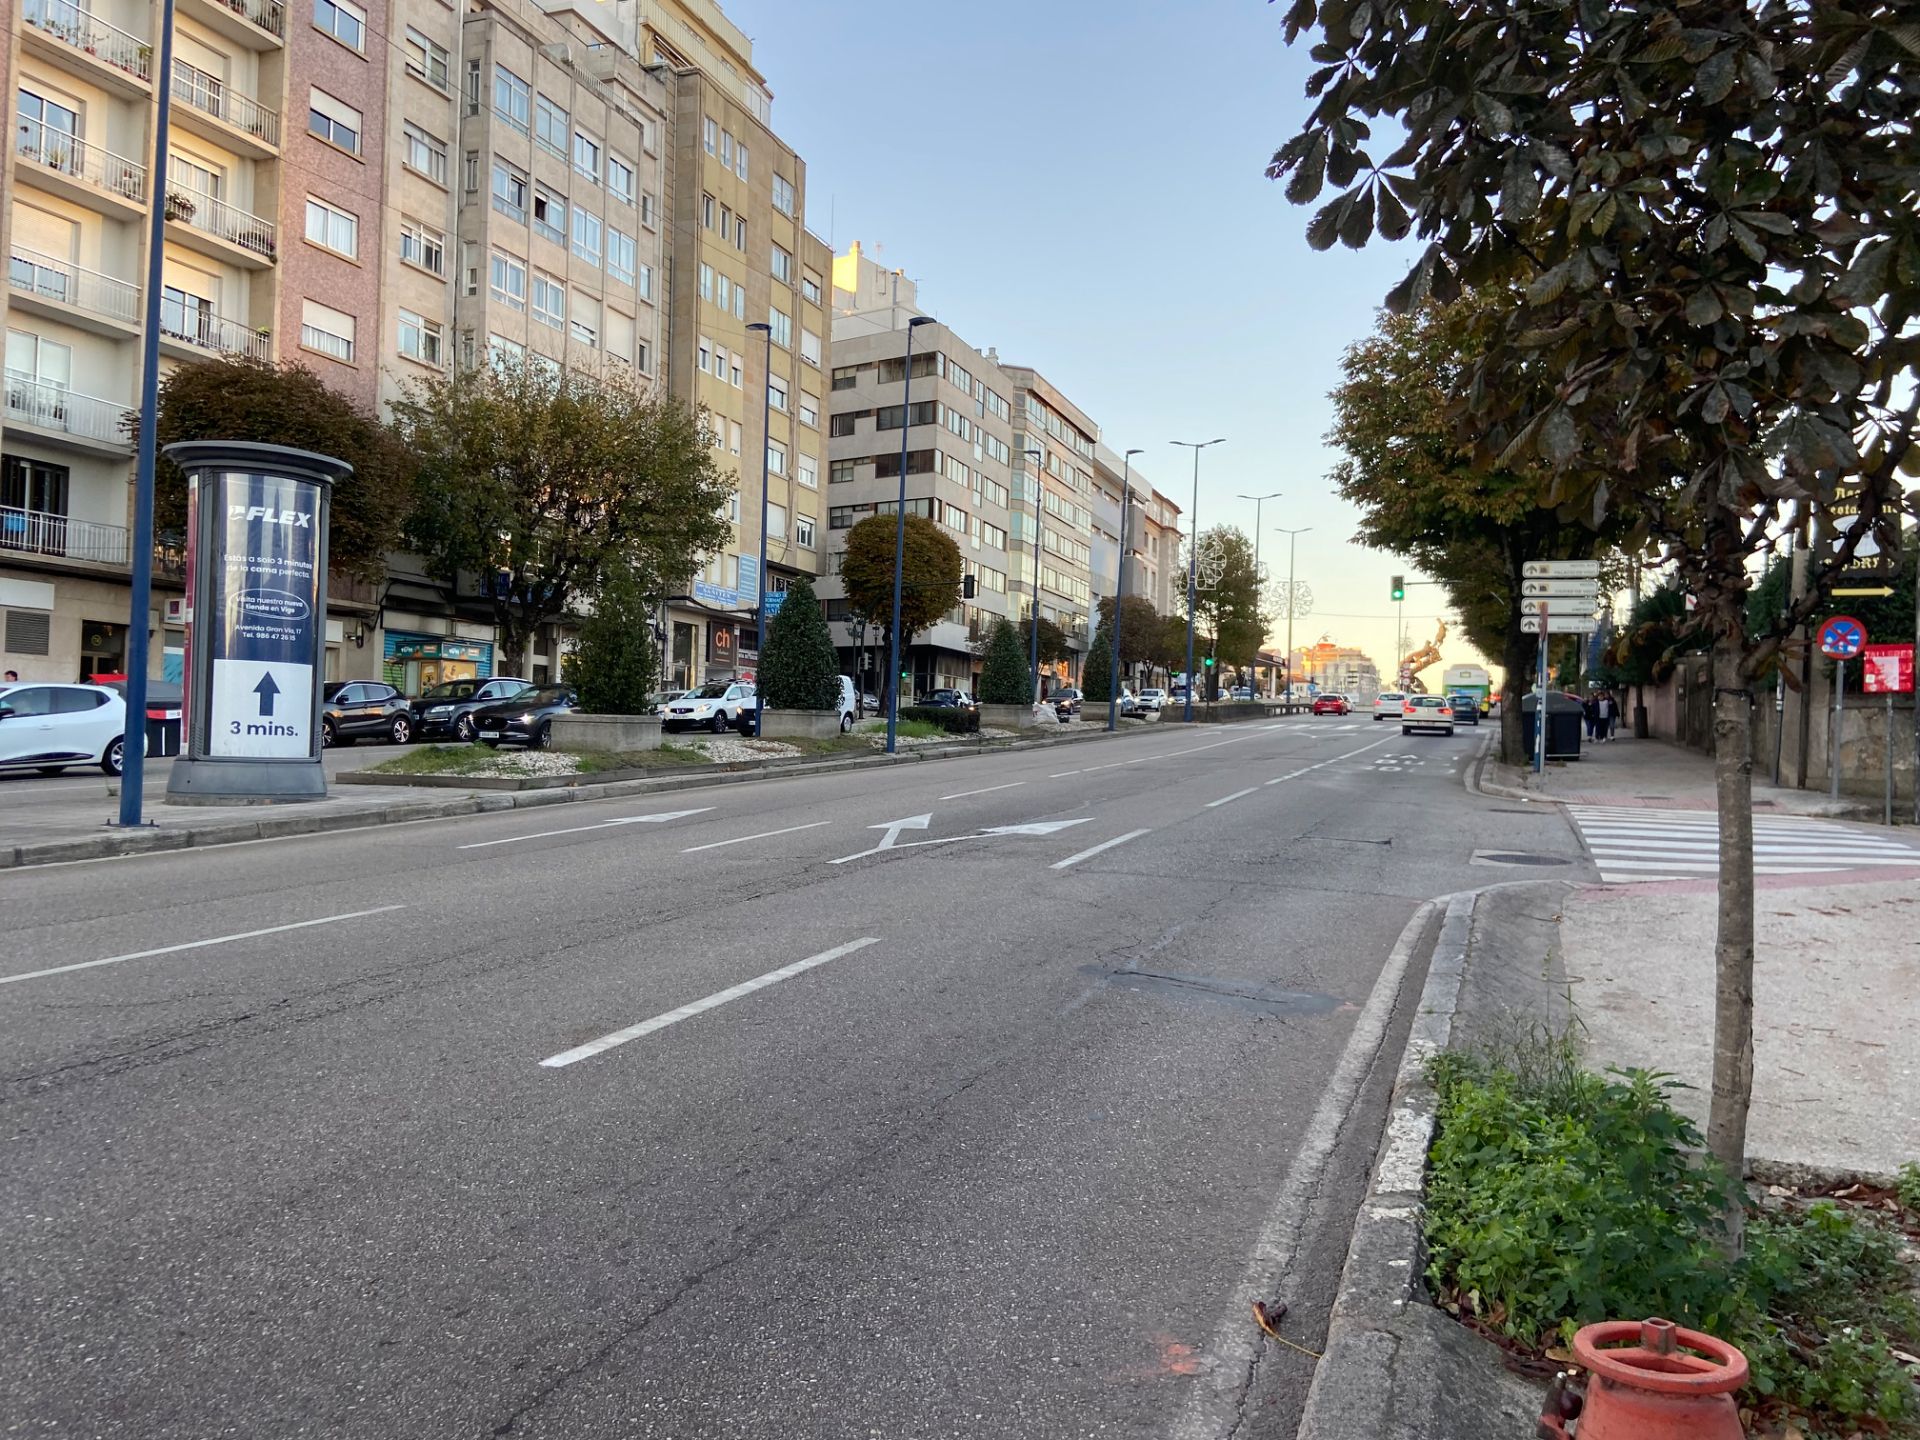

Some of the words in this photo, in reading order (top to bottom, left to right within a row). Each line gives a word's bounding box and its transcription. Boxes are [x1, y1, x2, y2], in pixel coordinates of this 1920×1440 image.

[246, 506, 311, 528] FLEX
[241, 564, 249, 572] la
[250, 566, 277, 574] cama
[276, 557, 283, 565] 3
[284, 558, 312, 569] minutos
[236, 595, 256, 603] Visita
[245, 603, 270, 611] tienda
[280, 605, 296, 615] Vigo
[235, 624, 265, 632] Avenida
[265, 625, 283, 633] Gran
[715, 628, 730, 649] ch
[230, 720, 241, 735] 3
[247, 720, 299, 737] mins.
